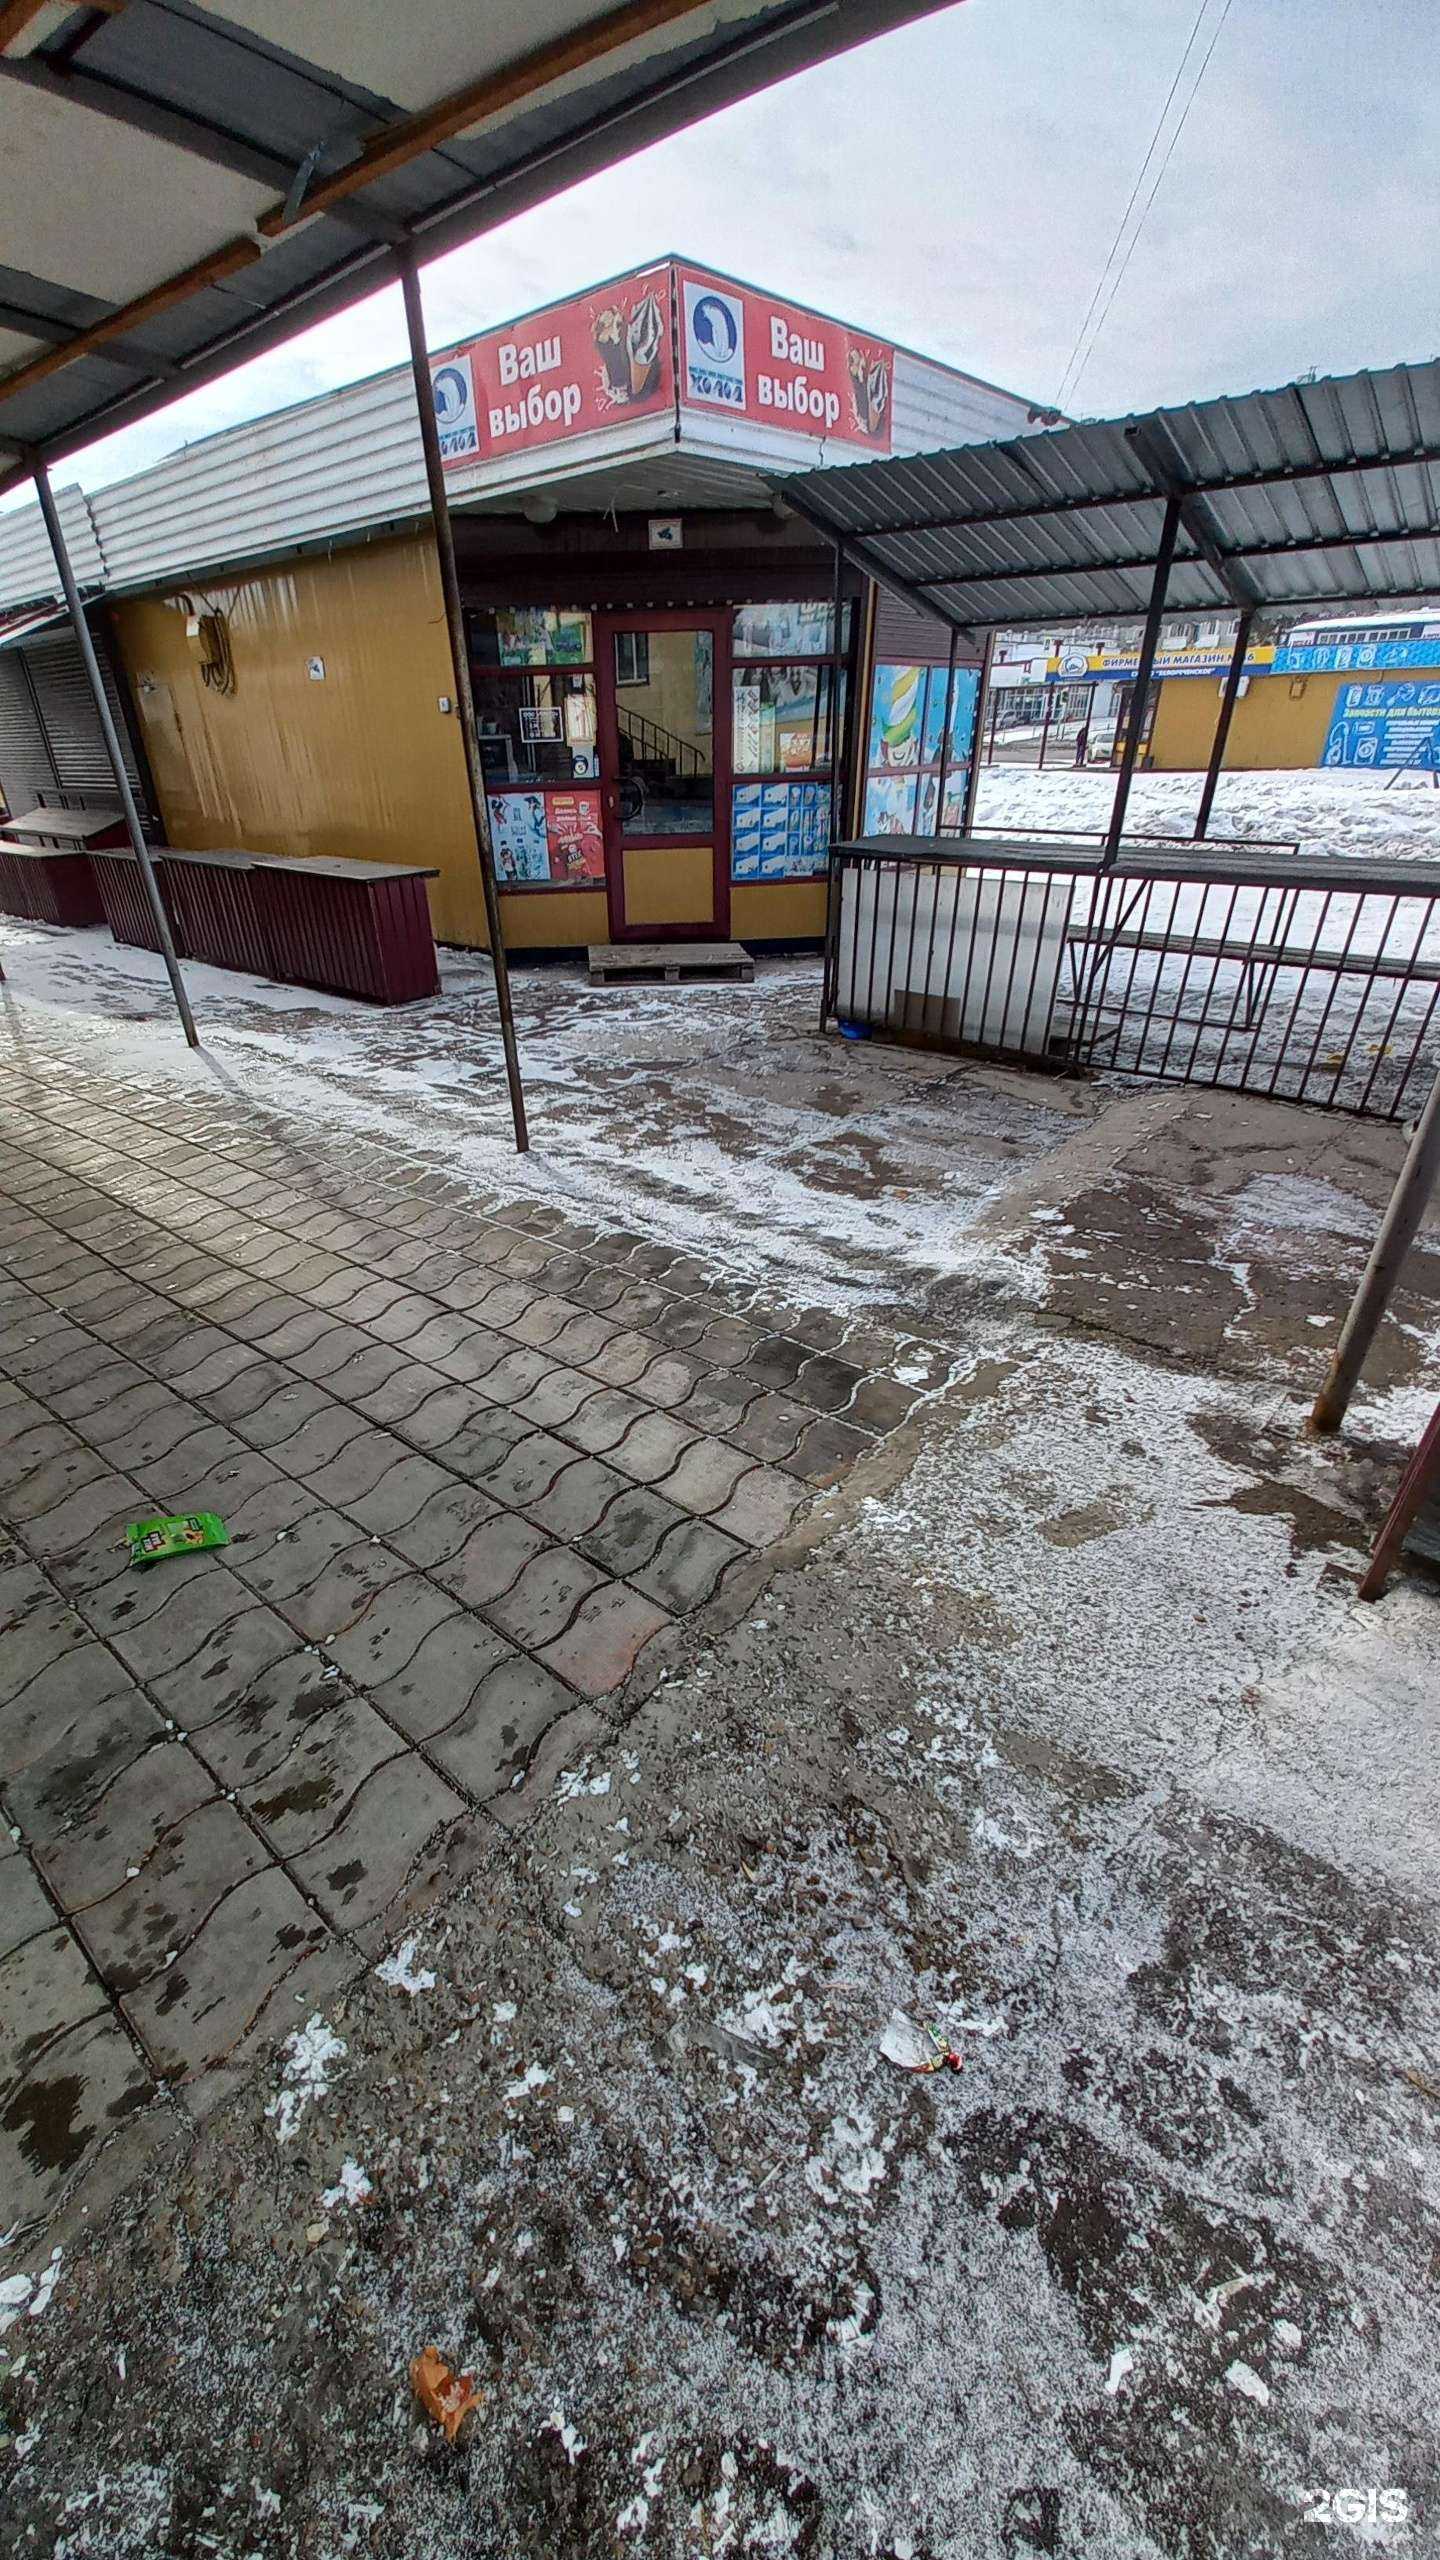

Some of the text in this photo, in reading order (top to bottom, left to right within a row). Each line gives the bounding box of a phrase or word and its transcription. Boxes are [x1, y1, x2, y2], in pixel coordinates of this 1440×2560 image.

[498, 335, 562, 386] Ваш
[771, 316, 825, 372] Ваш
[488, 383, 582, 439] выбор
[757, 373, 840, 429] выбор
[1173, 653, 1225, 664] МАГАЗИН
